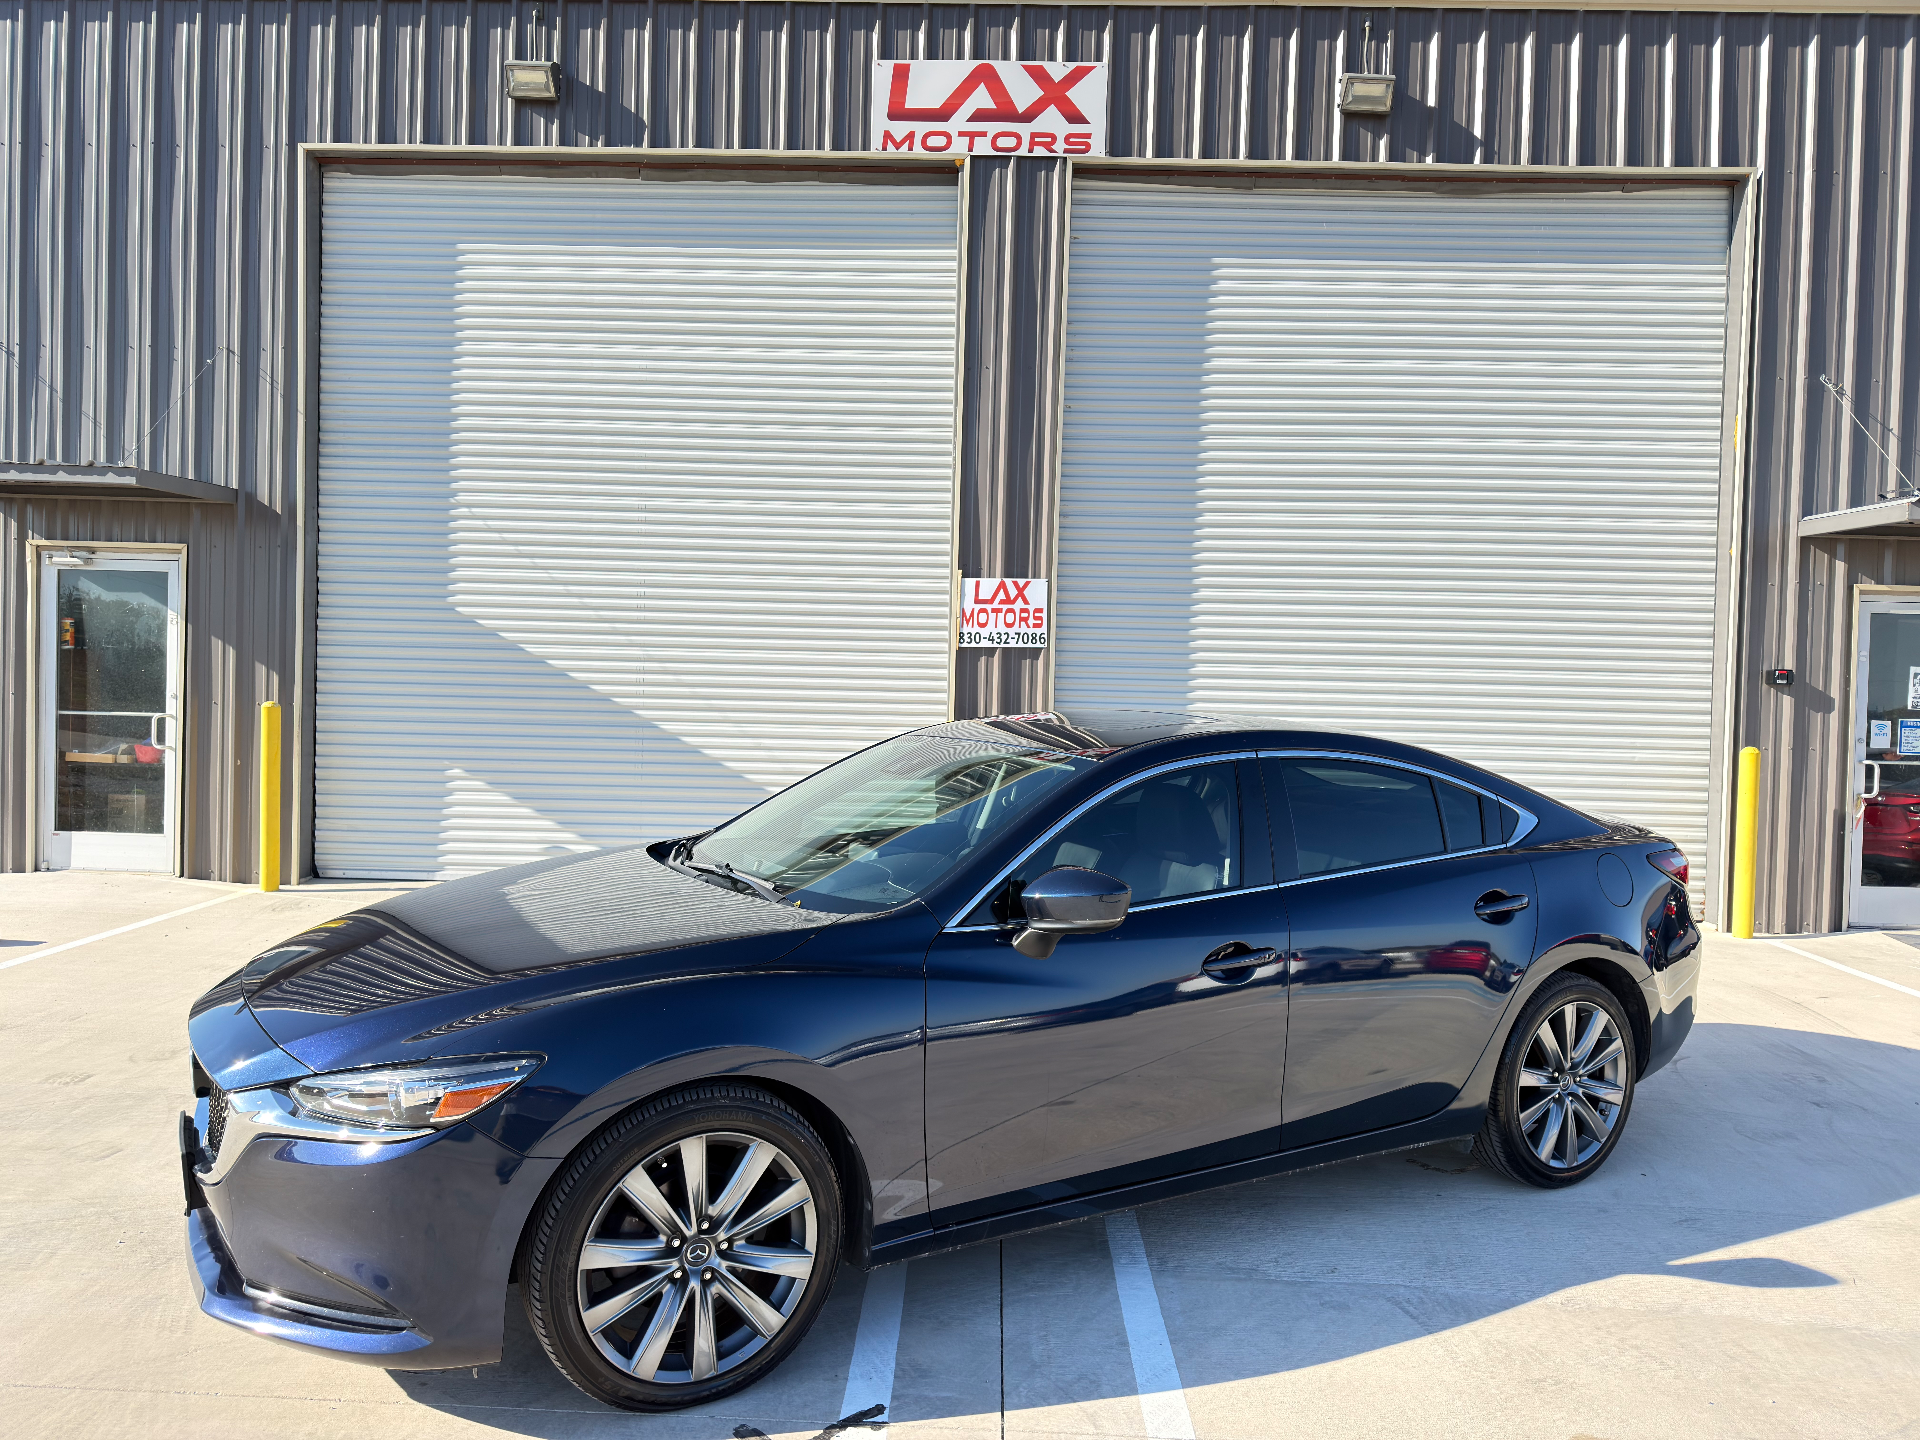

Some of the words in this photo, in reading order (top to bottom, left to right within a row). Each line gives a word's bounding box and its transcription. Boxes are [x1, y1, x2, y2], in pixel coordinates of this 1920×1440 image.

[886, 62, 1098, 124] LAX
[881, 130, 1093, 154] MOTORS
[974, 580, 1032, 605] LAX
[961, 607, 1044, 628] MOTORS
[958, 631, 1046, 645] 830-432-7086
[694, 1110, 753, 1123] YOKOHAMA
